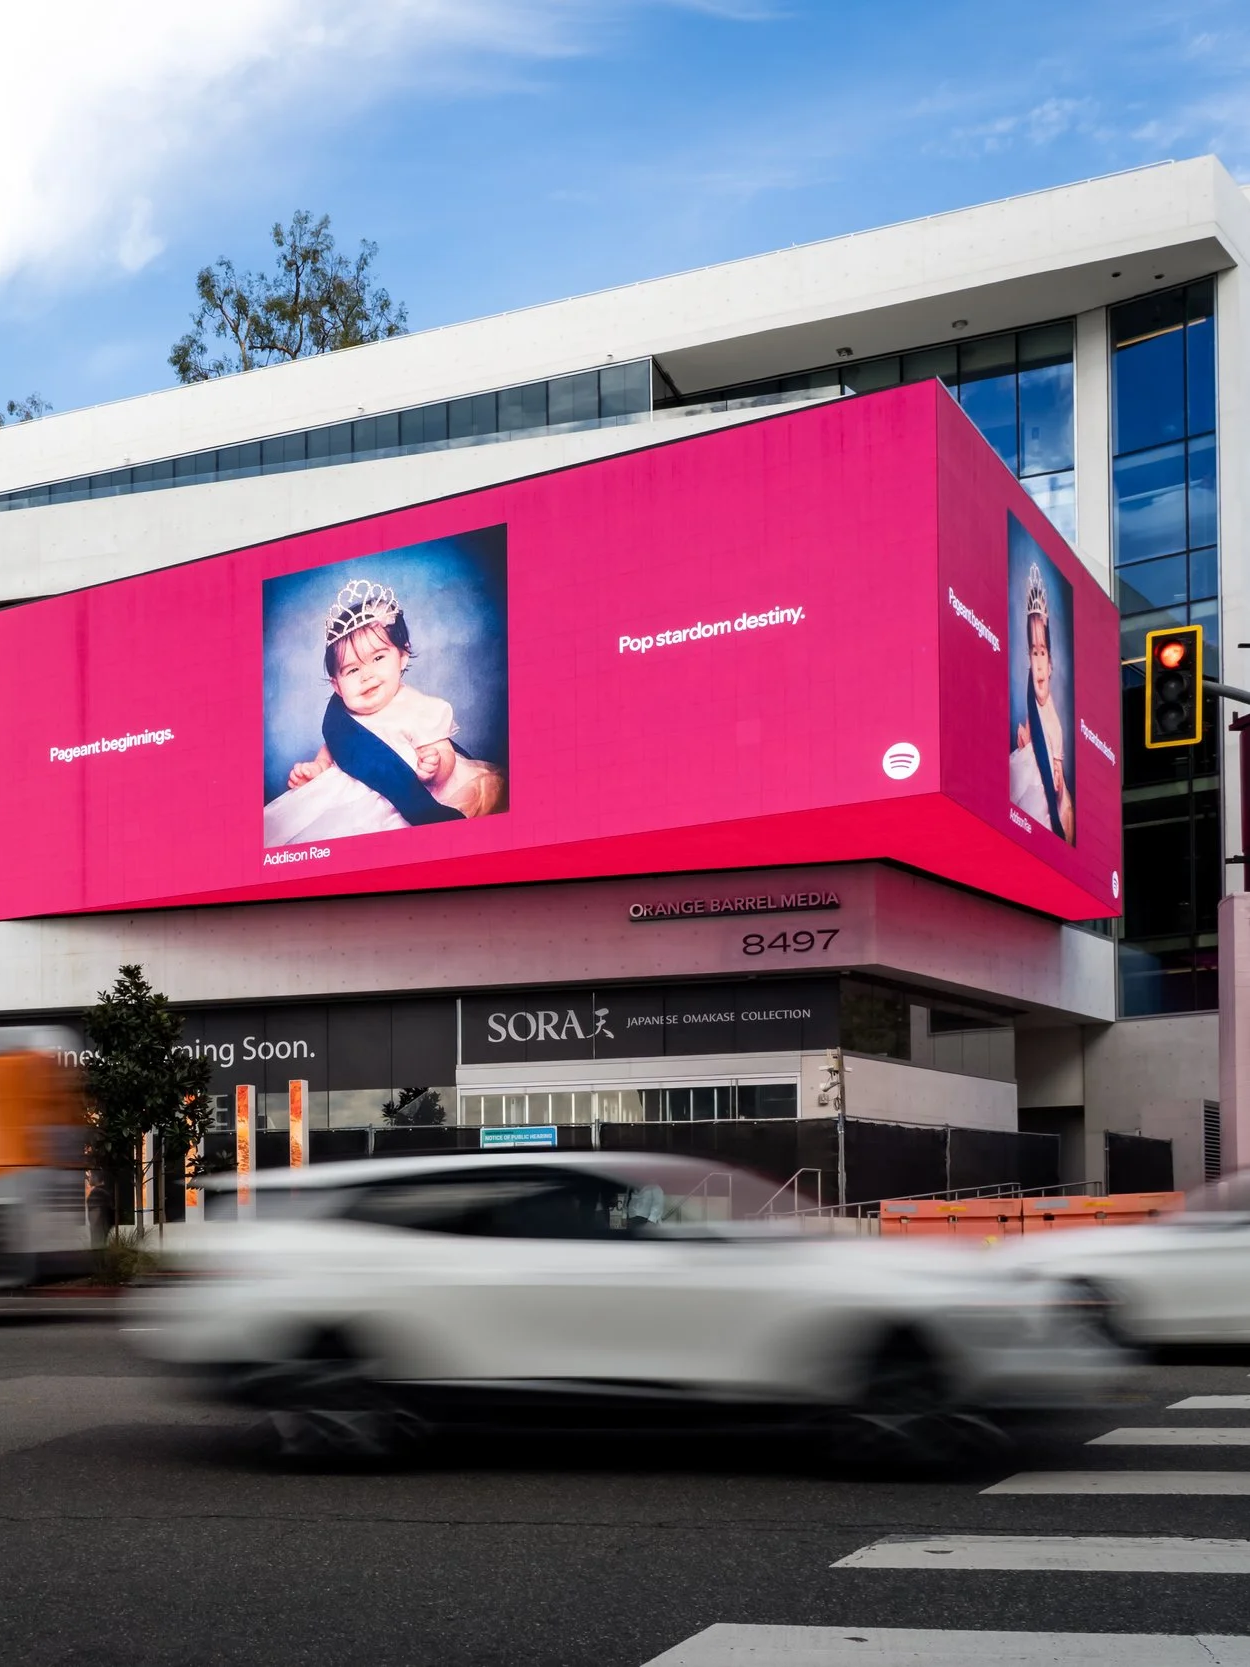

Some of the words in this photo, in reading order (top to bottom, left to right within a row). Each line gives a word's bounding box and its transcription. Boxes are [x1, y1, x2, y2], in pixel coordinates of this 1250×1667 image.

[619, 635, 653, 654] Pop
[655, 620, 731, 647] stardom
[734, 606, 806, 632] destiny.
[50, 740, 100, 762] Pageant
[101, 728, 175, 752] beginnings.
[263, 851, 308, 866] Addison
[309, 846, 331, 860] Rae
[629, 899, 705, 918] ORANGE
[710, 895, 779, 913] BARREL
[780, 891, 839, 908] MEDIA
[742, 928, 840, 956] 8497
[487, 1009, 586, 1043] SORA
[626, 1014, 679, 1028] JAPANESE
[682, 1012, 735, 1024] OMAKASE
[741, 1008, 811, 1021] COLLECTION
[242, 1036, 315, 1061] Soon.
